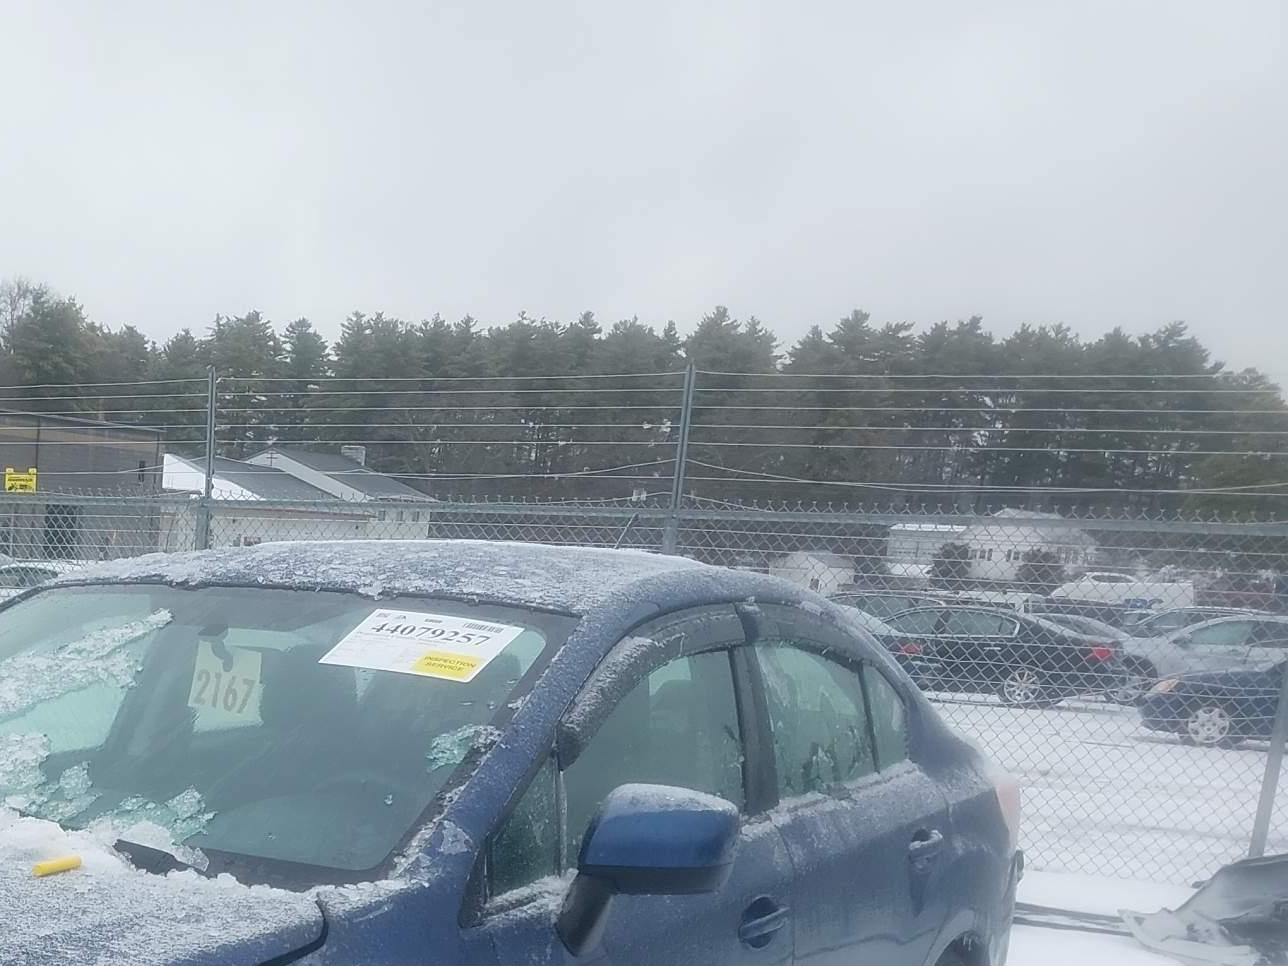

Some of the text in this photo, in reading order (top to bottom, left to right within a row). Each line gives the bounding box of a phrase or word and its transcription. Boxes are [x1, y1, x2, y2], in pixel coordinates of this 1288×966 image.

[371, 622, 491, 646] 44079257
[424, 656, 477, 668] INSPECTION
[424, 661, 465, 672] SERVICE
[192, 668, 257, 714] 2167
